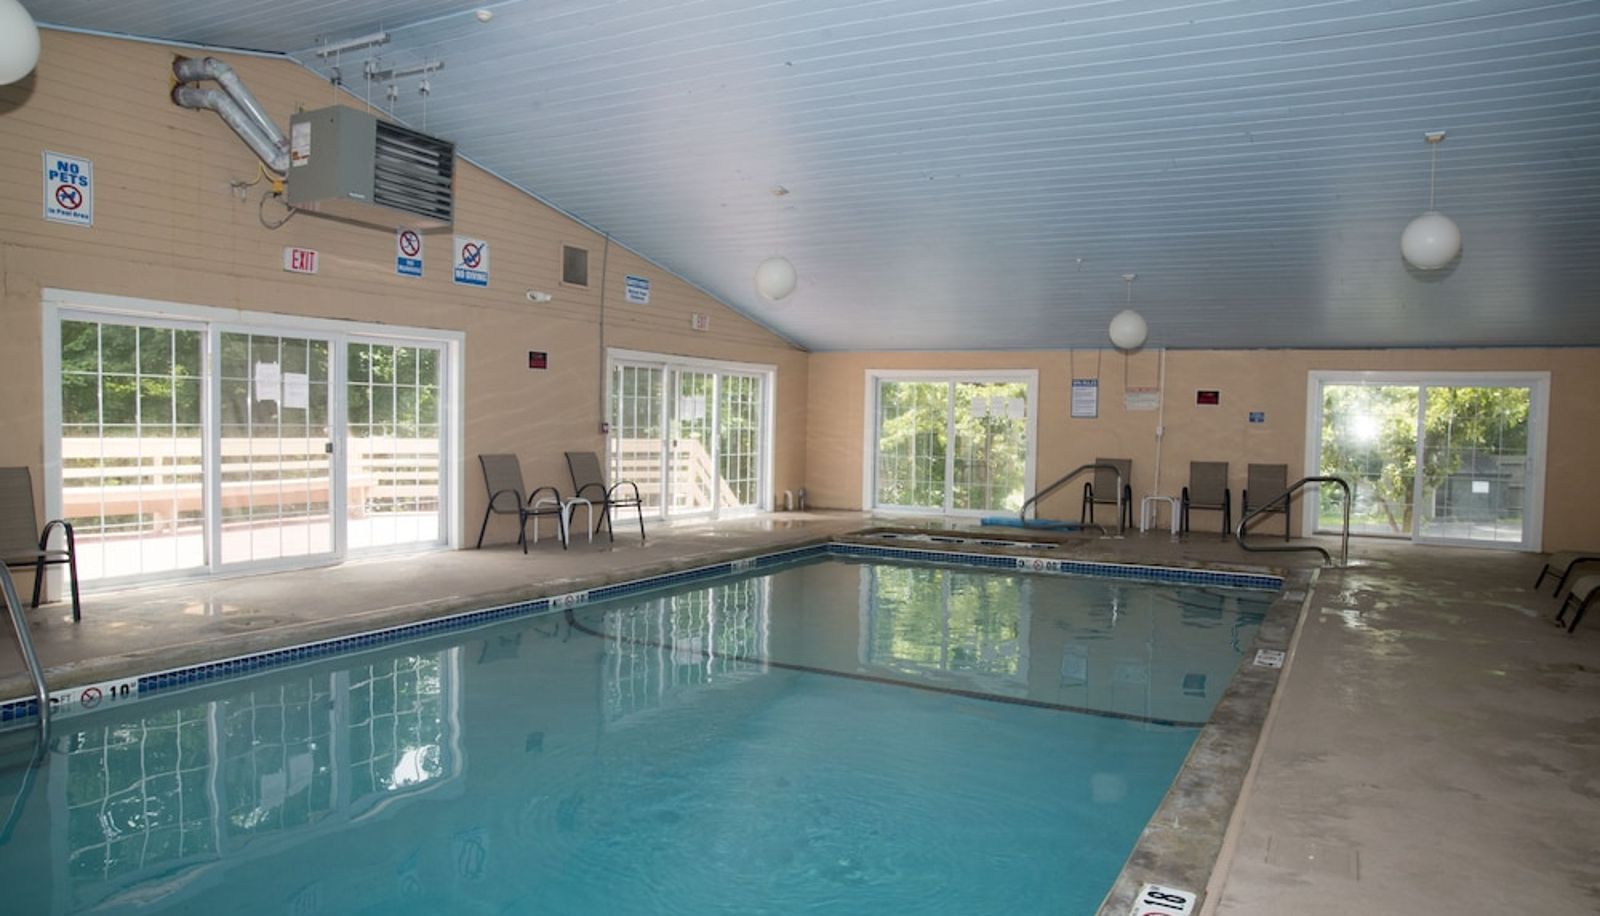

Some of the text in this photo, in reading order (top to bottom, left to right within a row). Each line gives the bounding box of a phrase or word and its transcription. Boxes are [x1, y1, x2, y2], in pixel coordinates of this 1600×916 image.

[57, 161, 79, 174] NO
[49, 169, 88, 186] PETS
[292, 249, 315, 272] EXIT
[455, 269, 465, 279] NO
[466, 271, 488, 282] DIVING
